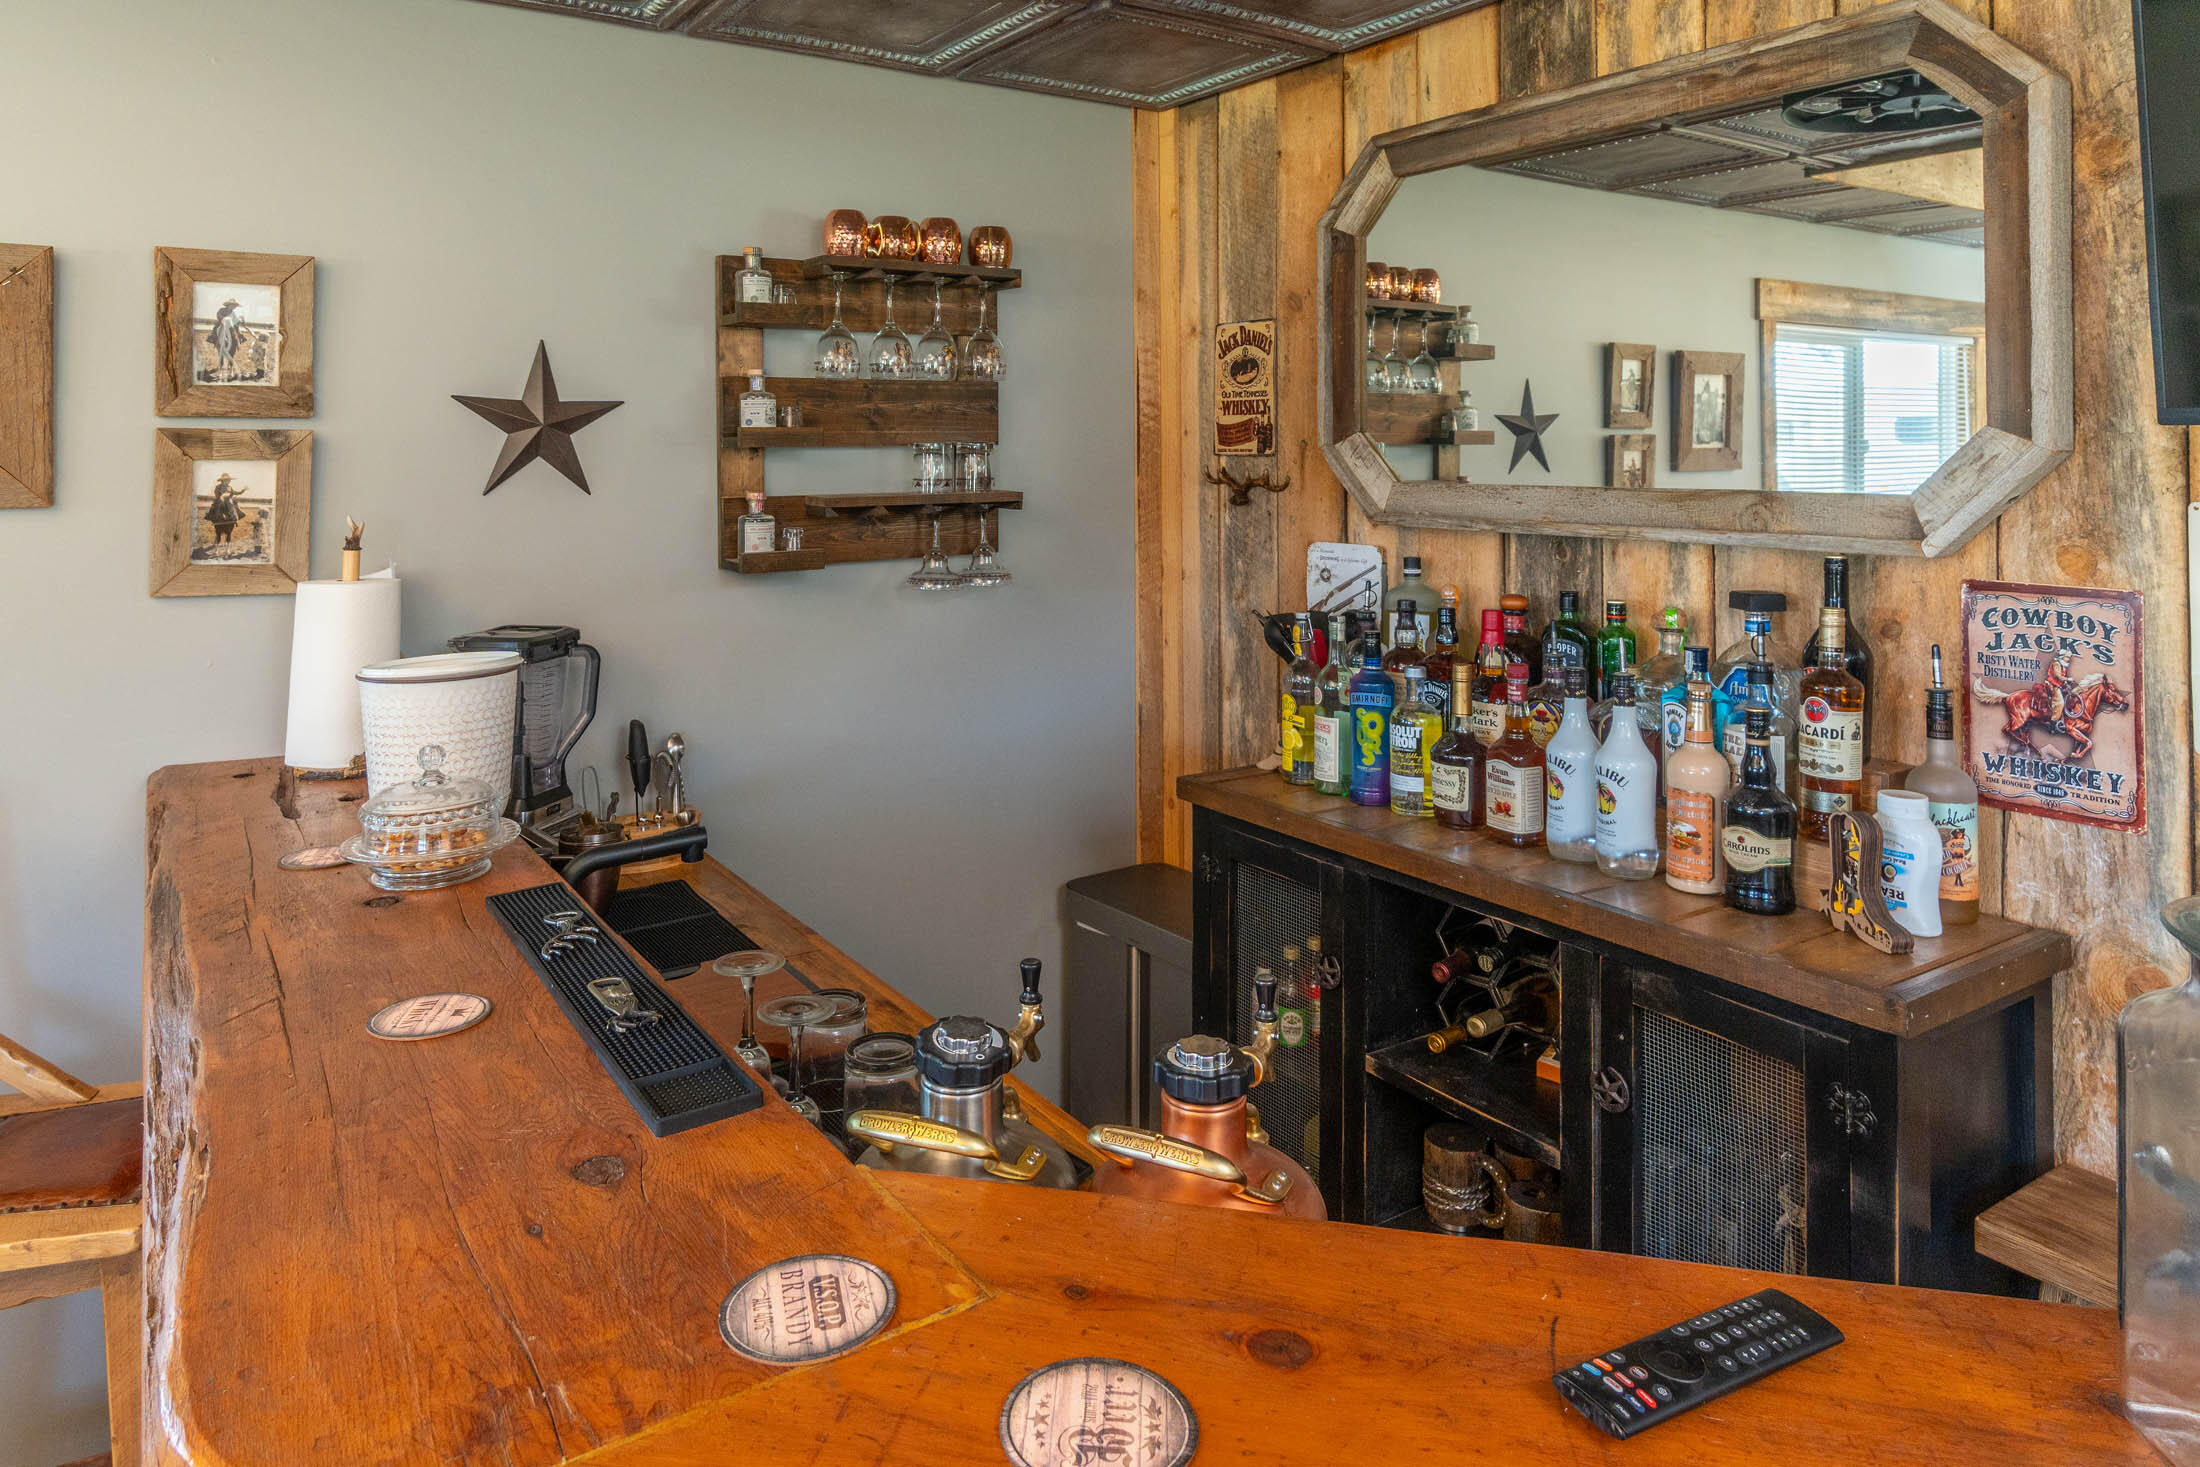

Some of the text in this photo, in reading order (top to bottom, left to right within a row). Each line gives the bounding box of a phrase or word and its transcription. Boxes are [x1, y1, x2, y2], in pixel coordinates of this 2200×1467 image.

[1217, 325, 1273, 360] JACK DANIEL'S
[1232, 390, 1243, 399] TIME
[1244, 389, 1269, 398] TENNESSEE
[1222, 398, 1269, 416] WHISKEY
[1981, 606, 2120, 644] COWBOY
[1547, 642, 1577, 657] POPER
[1984, 631, 2116, 666] JACK'S
[1977, 651, 2041, 670] RUSTY WATER
[1983, 664, 2036, 682] DISTILLERY
[1472, 707, 1498, 717] ker's
[1391, 724, 1423, 738] SOLUT
[1800, 724, 1846, 741] ACARDÍ
[1487, 771, 1516, 786] Williams
[1491, 764, 1509, 777] Evan
[1981, 751, 2125, 796] WHISKEY
[1985, 776, 2032, 790] TIME HONORED
[2037, 785, 2052, 795] SINCE
[2069, 791, 2121, 806] TRADITION
[1723, 837, 1771, 856] CAROLANS
[780, 1267, 814, 1347] BRANDY
